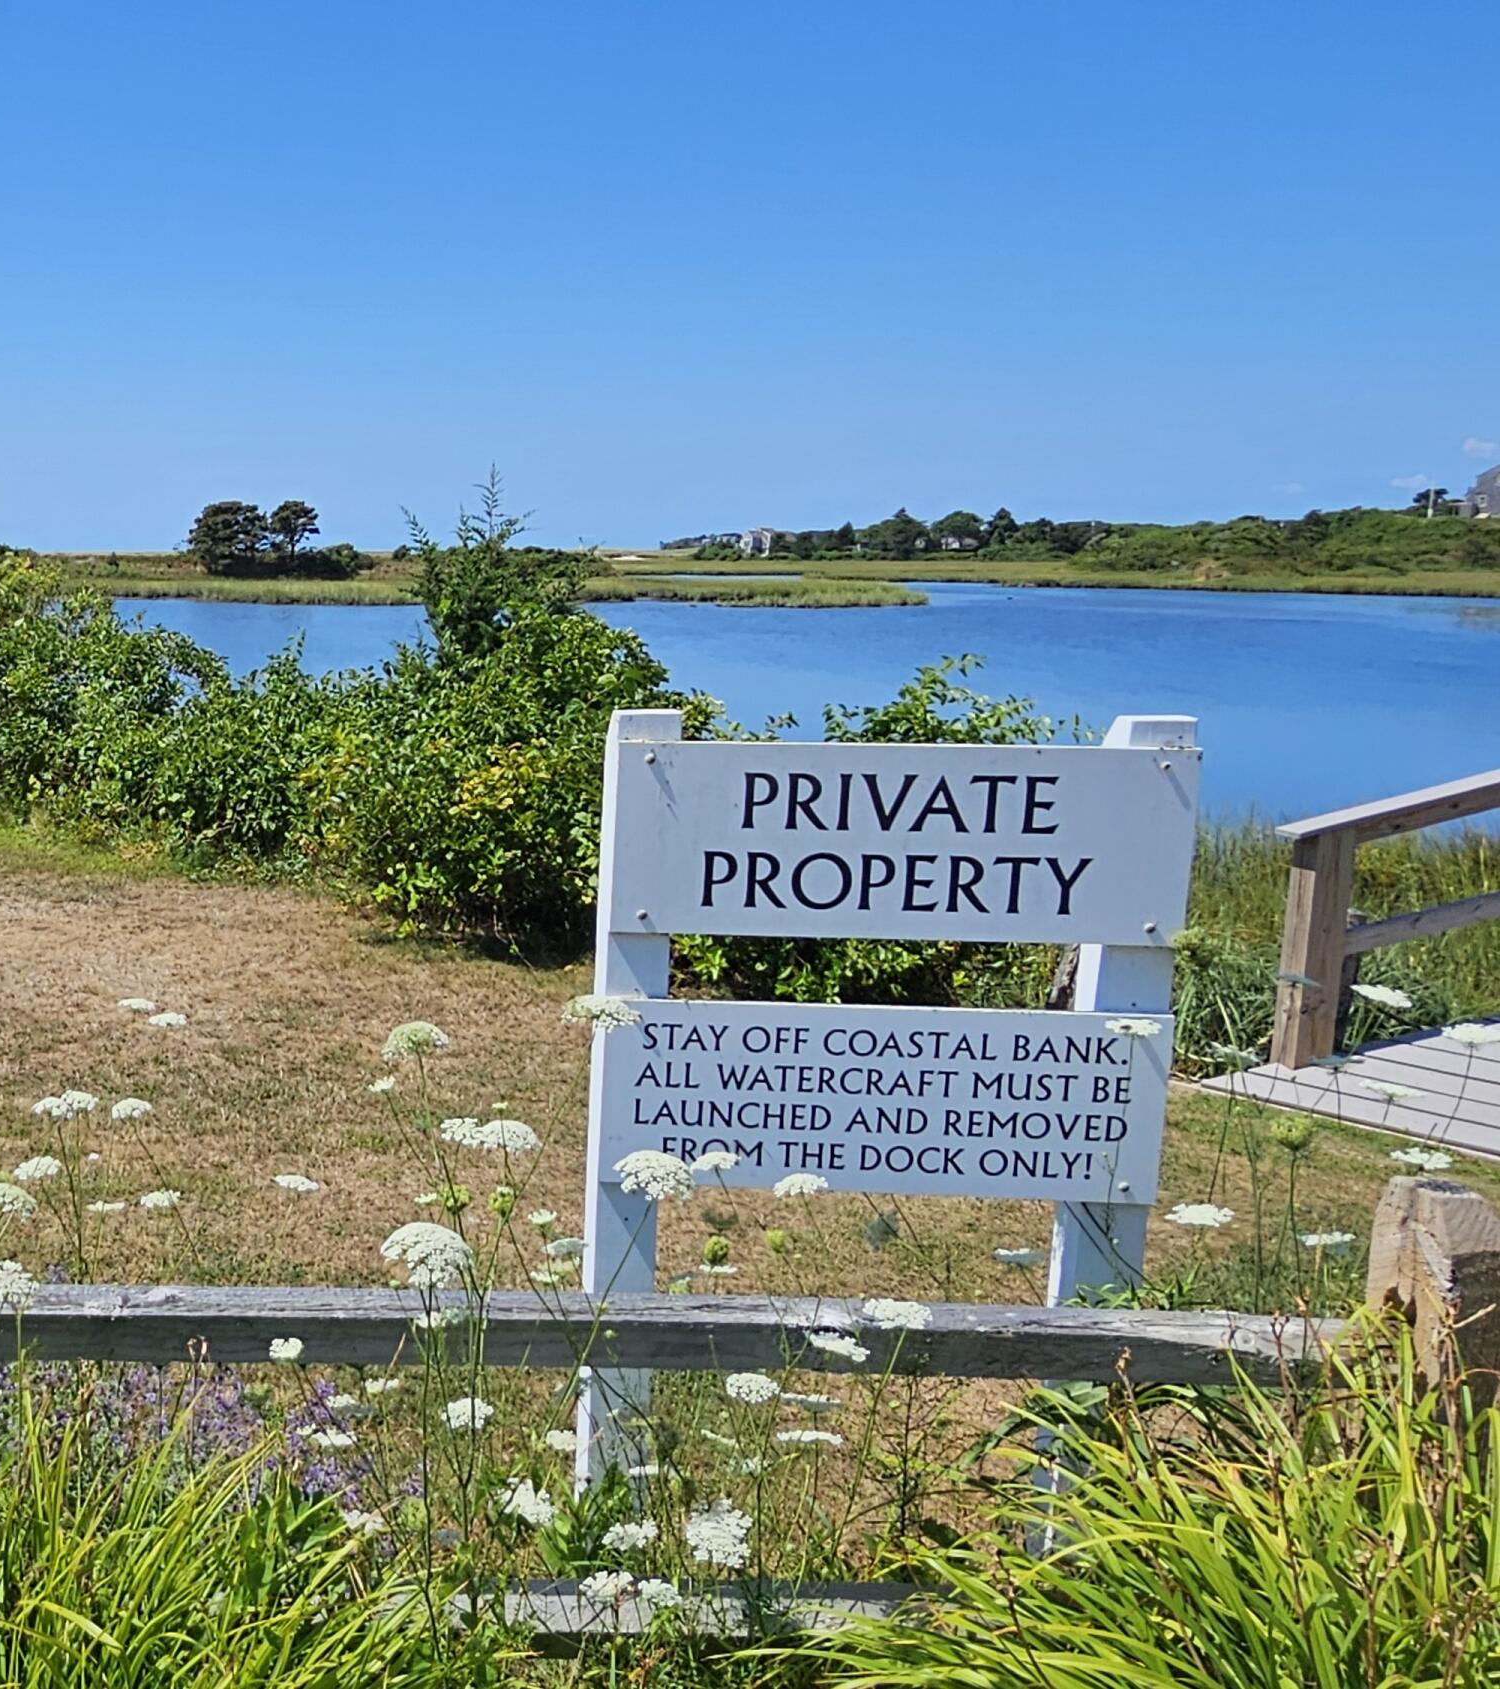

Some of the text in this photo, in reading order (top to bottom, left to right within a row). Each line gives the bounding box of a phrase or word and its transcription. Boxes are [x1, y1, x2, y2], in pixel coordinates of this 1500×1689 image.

[742, 773, 1059, 834] PRIVATE
[701, 851, 1093, 915] PROPERTY
[643, 1023, 1128, 1065] STAY OFF COASTAL BANK.
[635, 1062, 1131, 1104] ALL WATERCRAFT MUST BE
[634, 1099, 1127, 1142] LAUNCHED AND REMOVED
[778, 1142, 845, 1170] THE
[860, 1145, 964, 1175] DOCK
[979, 1150, 1092, 1180] ONLY!
